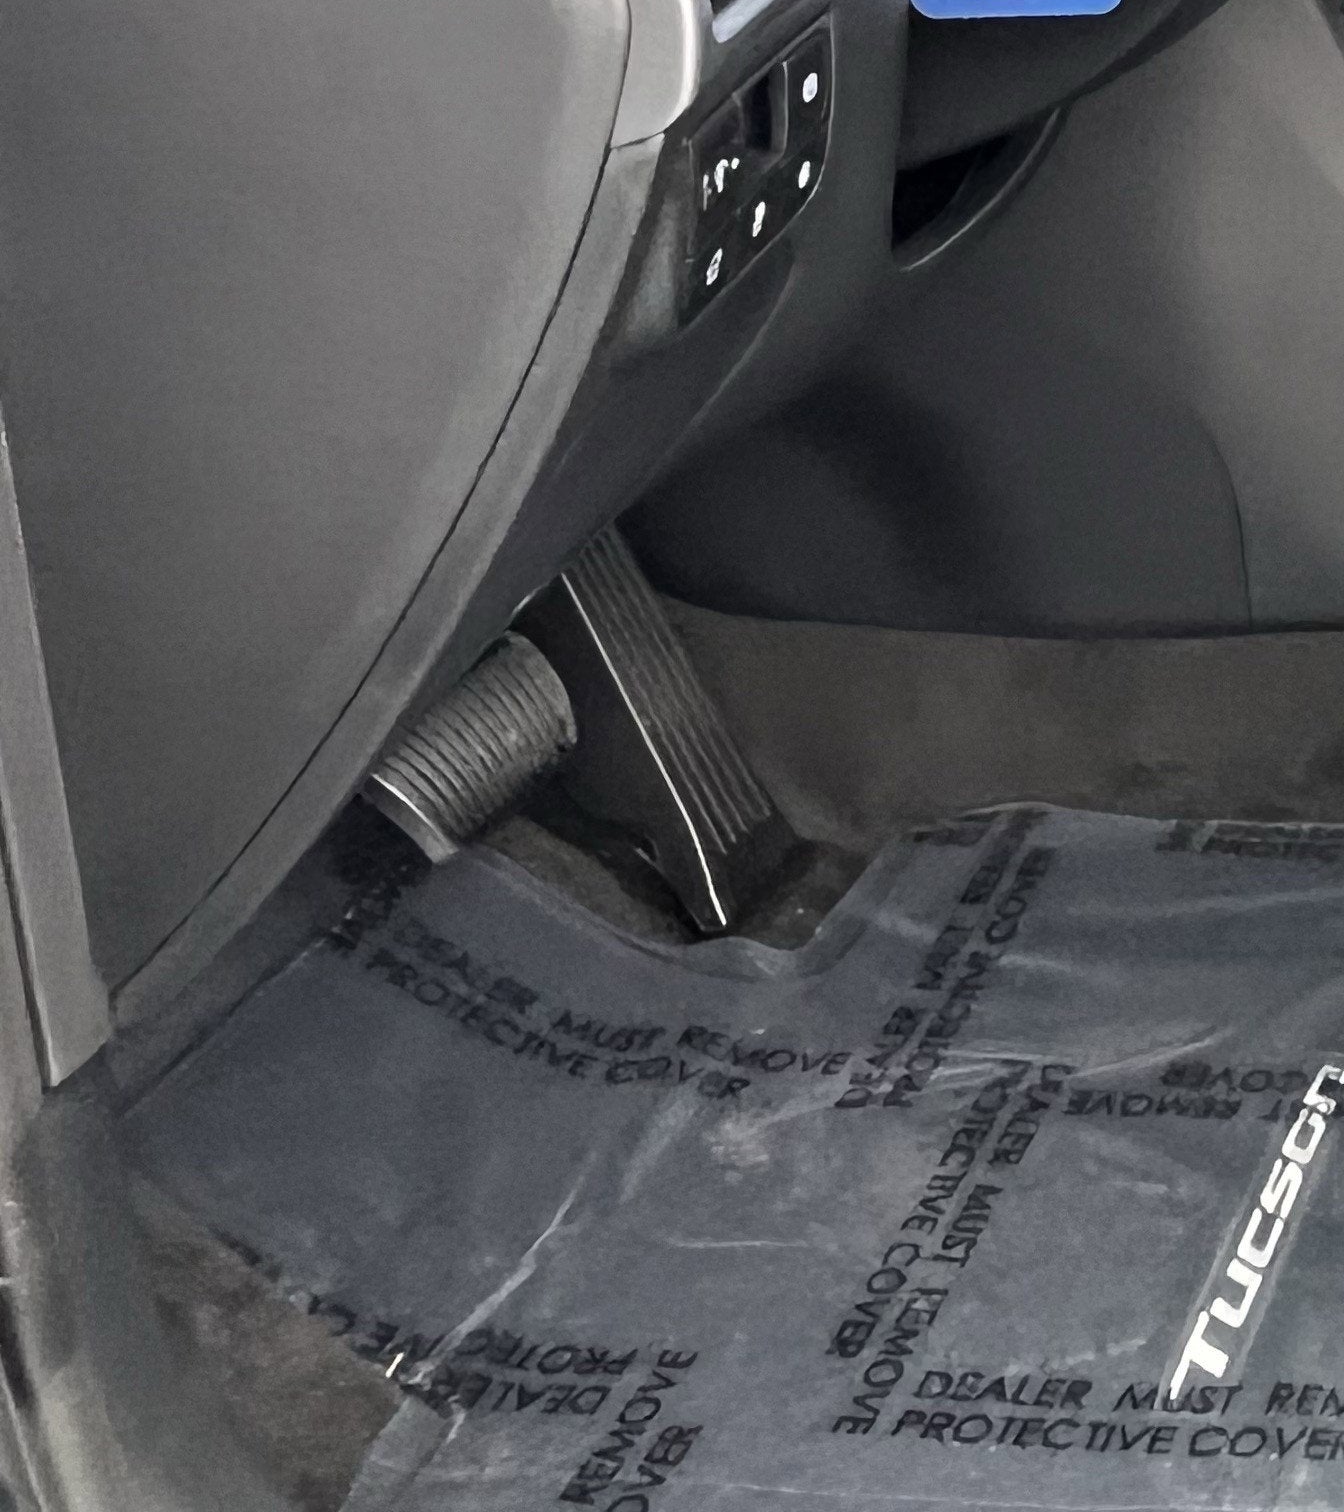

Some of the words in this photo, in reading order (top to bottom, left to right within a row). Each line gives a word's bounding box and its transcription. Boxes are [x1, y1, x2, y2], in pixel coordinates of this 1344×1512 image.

[911, 1369, 1094, 1412] DEALER
[1112, 1381, 1244, 1418] MUST
[890, 1408, 1176, 1456] PROTECTIVE
[606, 1424, 704, 1512] OVER
